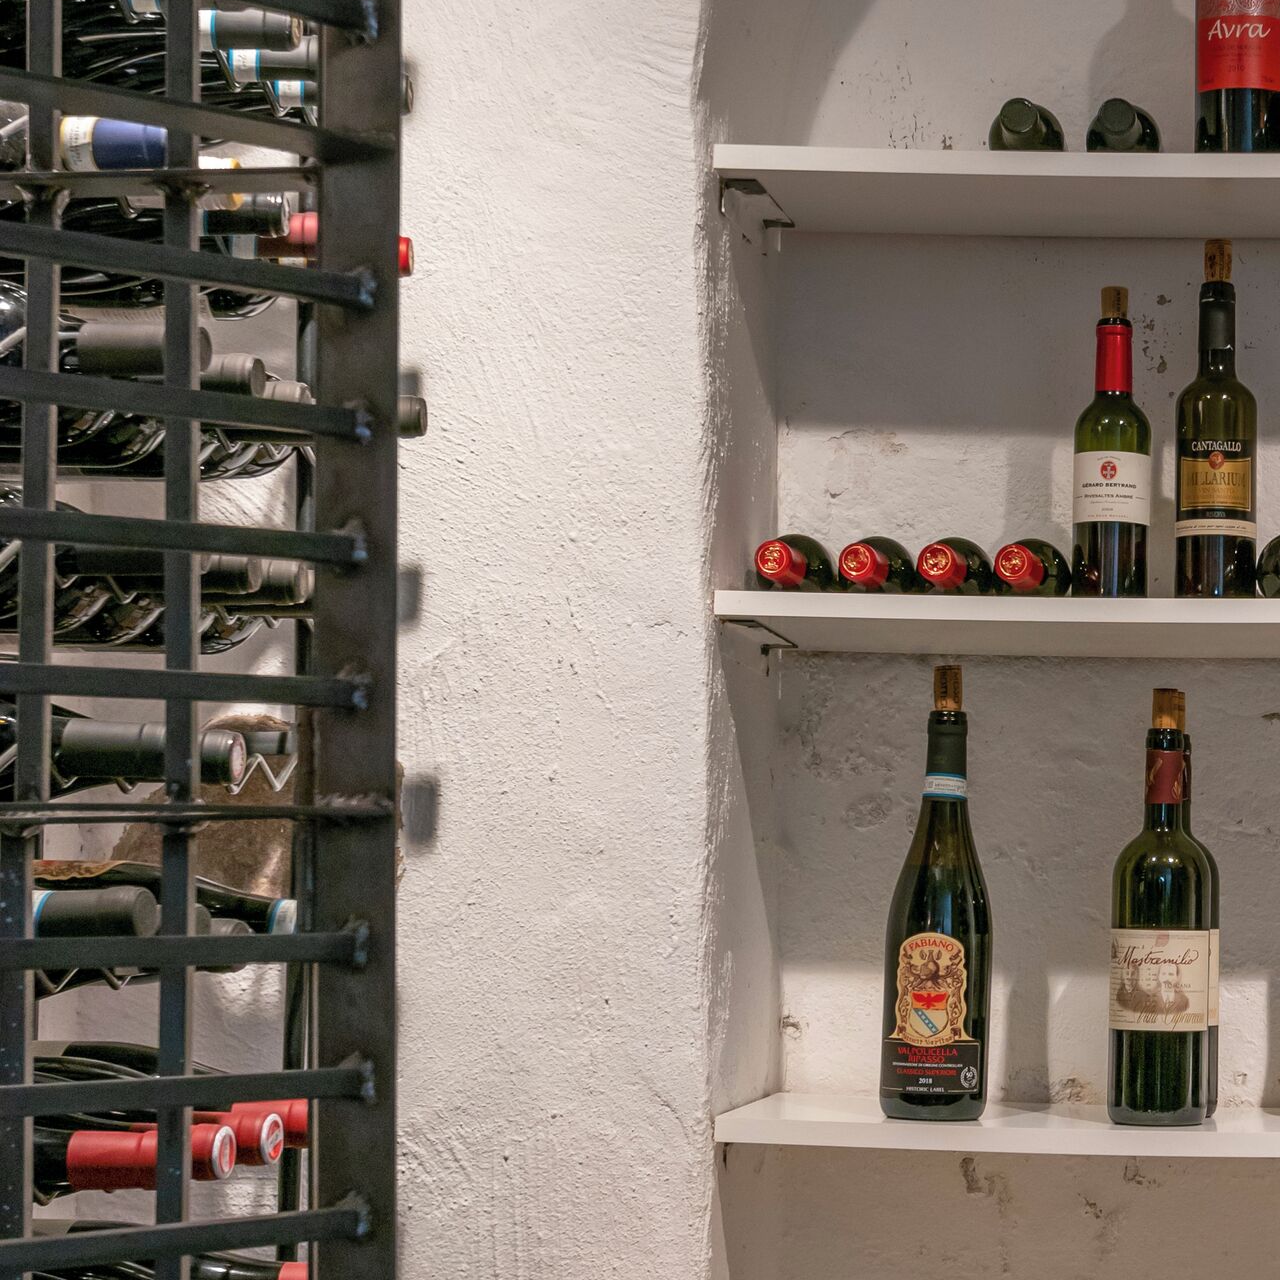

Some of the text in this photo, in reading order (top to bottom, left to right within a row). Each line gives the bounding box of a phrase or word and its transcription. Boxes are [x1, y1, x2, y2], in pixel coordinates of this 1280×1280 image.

[1208, 19, 1271, 40] Avra
[1191, 440, 1242, 452] CANTAGALLO
[1105, 482, 1137, 490] BERTRAND
[908, 938, 955, 952] FABIANO
[1118, 946, 1199, 969] Mastremilio
[897, 1047, 958, 1056] VALPOLICELLA
[908, 1055, 945, 1063] RIPASSO
